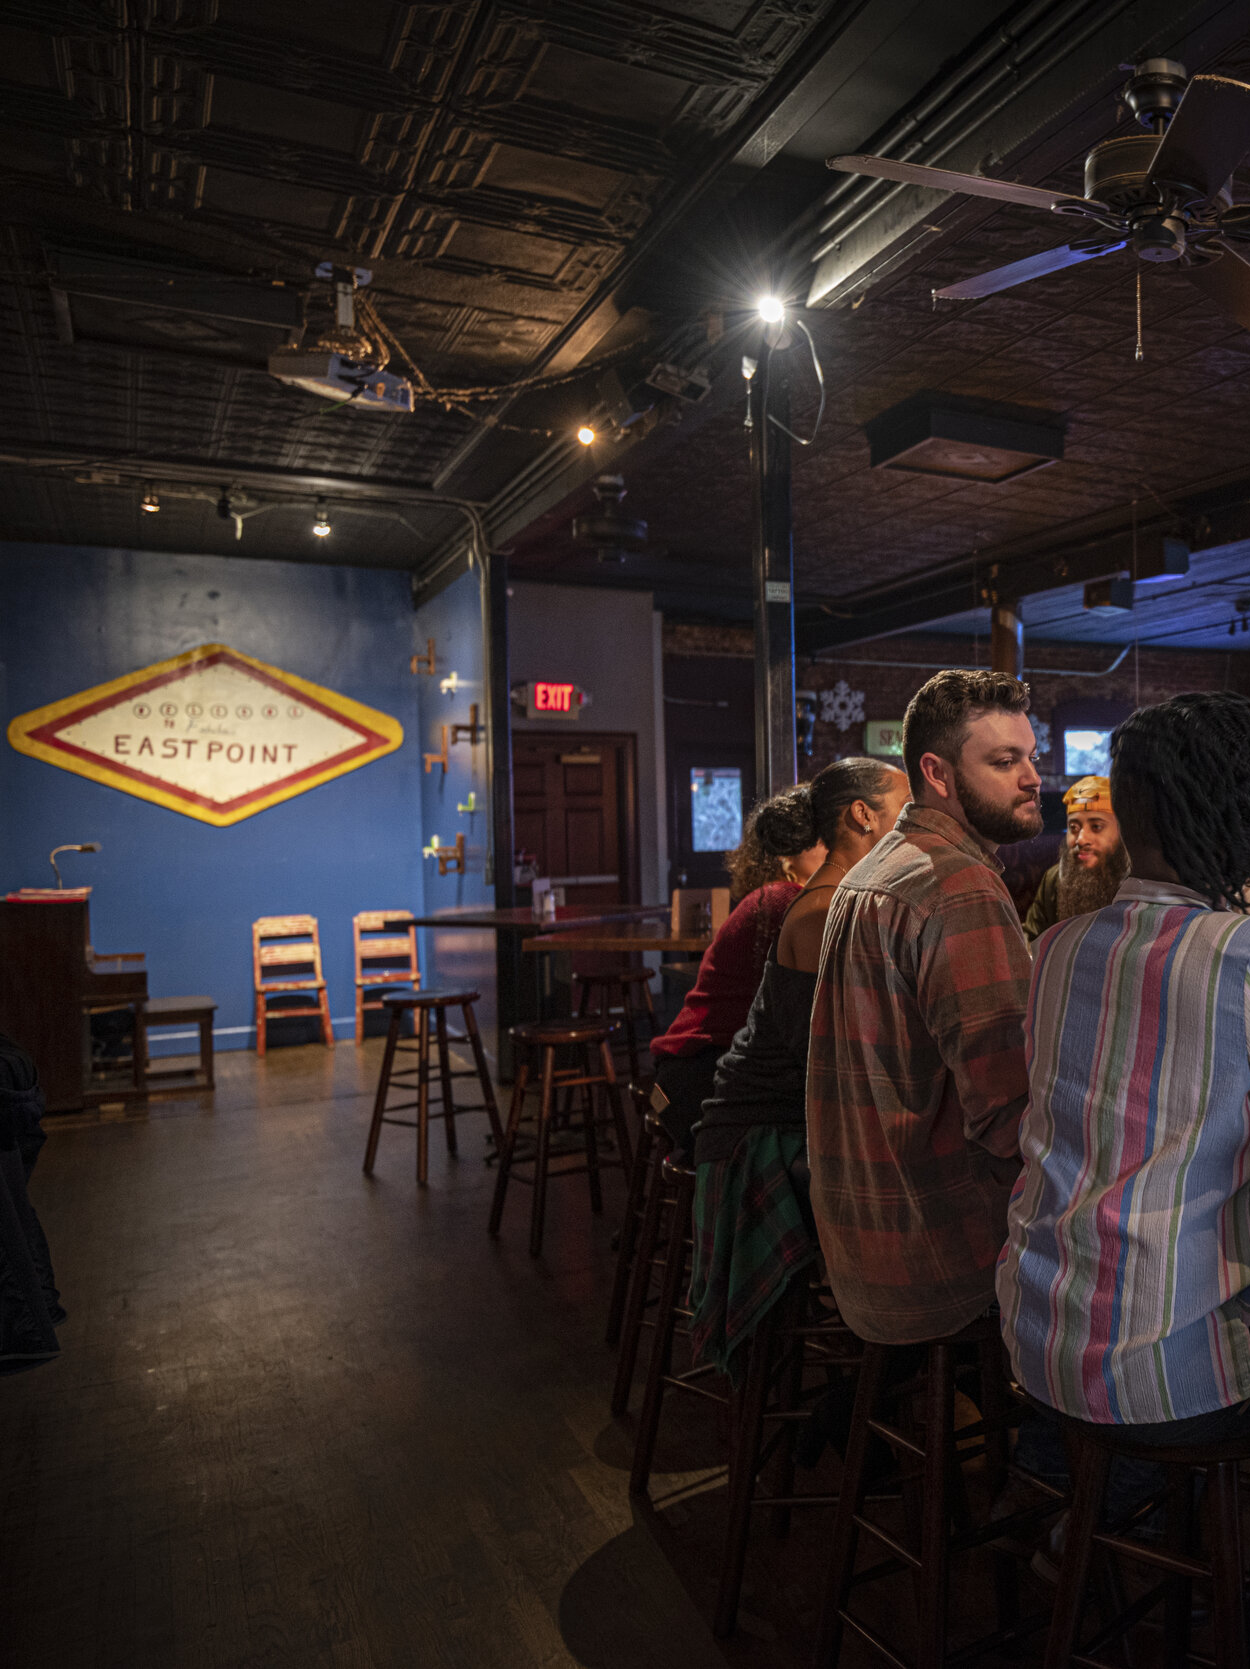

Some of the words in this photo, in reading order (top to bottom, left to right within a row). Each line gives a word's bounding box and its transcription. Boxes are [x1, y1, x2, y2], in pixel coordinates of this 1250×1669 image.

[535, 682, 574, 711] EXIT
[114, 734, 199, 760] EAST
[206, 740, 299, 764] POINT
